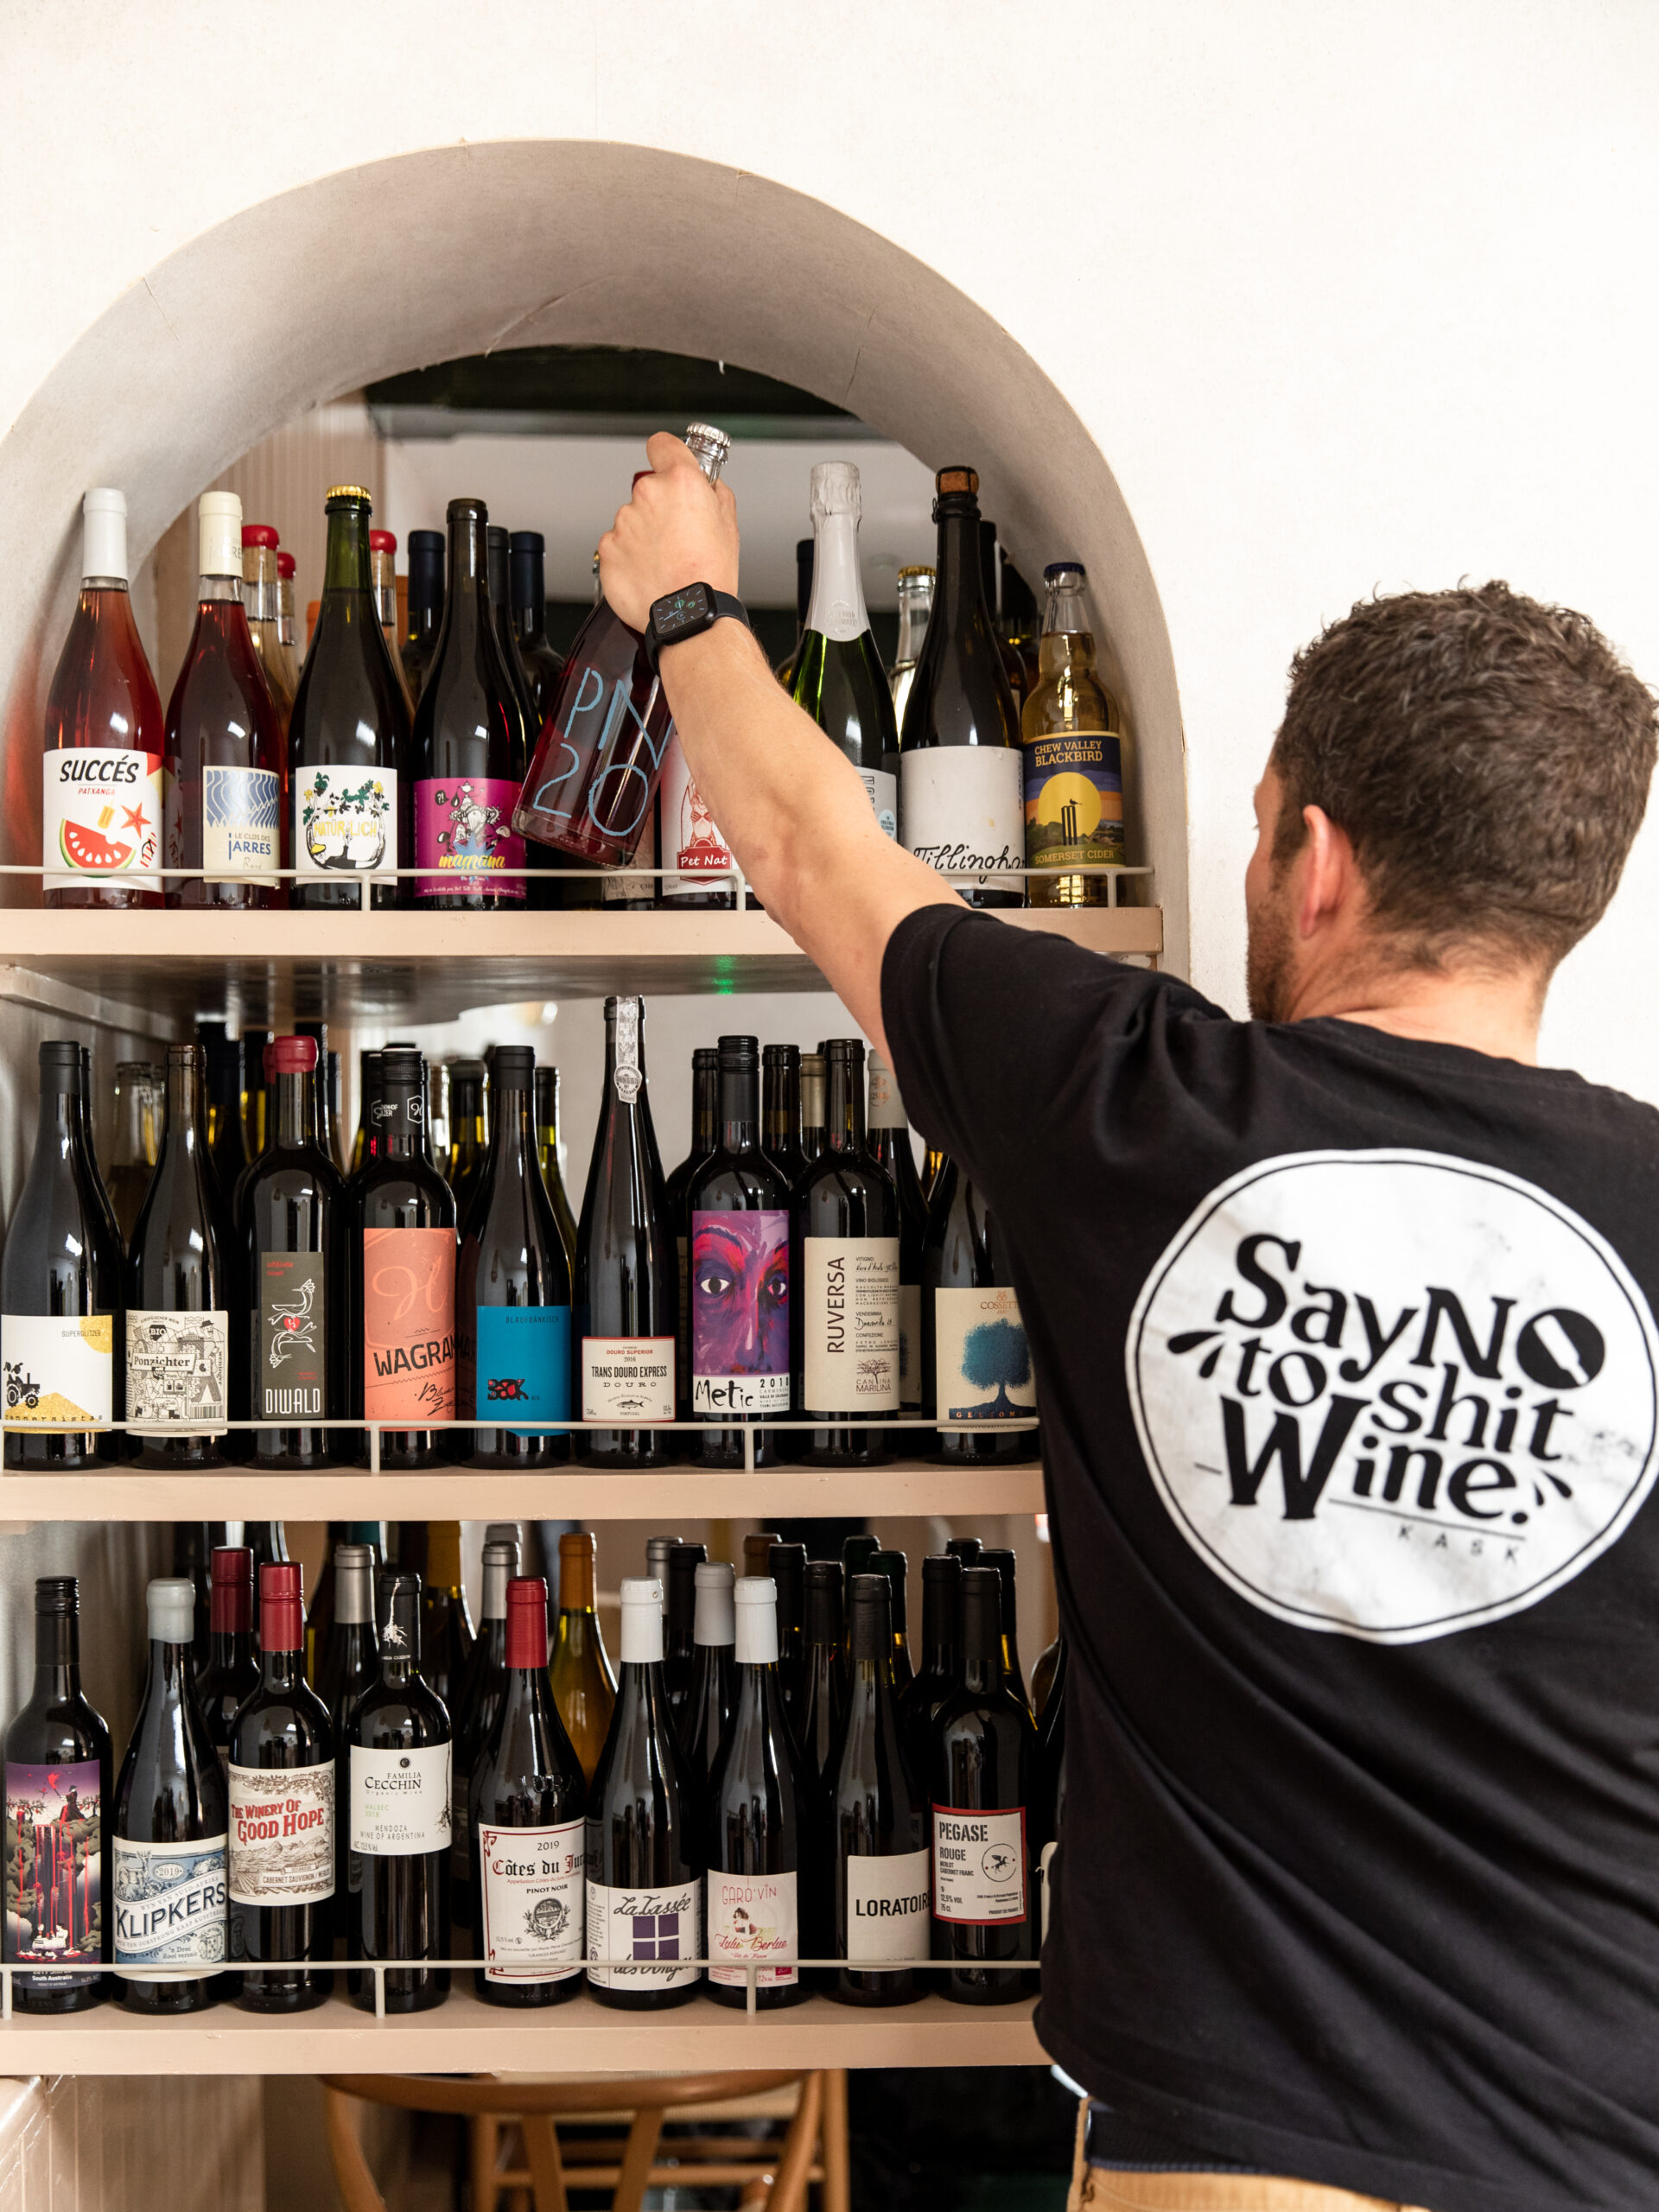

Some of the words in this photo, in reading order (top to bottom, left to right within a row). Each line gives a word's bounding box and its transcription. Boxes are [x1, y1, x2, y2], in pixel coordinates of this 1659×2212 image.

[1034, 742, 1062, 755] CHEW
[1065, 741, 1102, 751] VALLEY
[1035, 751, 1103, 767] BLACKBIRD
[60, 754, 140, 784] SUCCÉS
[78, 787, 116, 796] PATXANGA
[533, 742, 648, 836] 20
[680, 855, 701, 868] Pet
[703, 854, 728, 866] Nat
[1034, 850, 1085, 864] SOMERSET
[1086, 850, 1115, 859] CIDER
[827, 1255, 846, 1354] RUVERSA
[1214, 1232, 1420, 1382] Say
[1409, 1286, 1606, 1390] NO
[149, 1327, 167, 1337] BIO
[134, 1356, 190, 1368] Ponzichter
[592, 1366, 613, 1378] TRANS
[613, 1366, 638, 1378] DOURO
[639, 1365, 668, 1378] EXPRESS
[265, 1388, 321, 1414] DIWALD
[695, 1379, 754, 1410] Metic
[1235, 1337, 1328, 1408] to
[1370, 1360, 1575, 1461] shit
[1219, 1392, 1530, 1525] Wine.
[1397, 1524, 1520, 1565] KASK
[365, 1777, 422, 1790] CECCHIN
[245, 1802, 284, 1819] WINERY
[238, 1820, 279, 1846] GOOD
[283, 1808, 324, 1837] HOPE
[939, 1821, 988, 1842] PEGASE
[387, 1832, 425, 1840] ARGENTINA
[537, 1840, 560, 1851] 2019
[939, 1847, 966, 1861] ROUGE
[492, 1859, 536, 1876] Côtes
[542, 1860, 560, 1874] du
[940, 1867, 958, 1876] CABERNET
[115, 1882, 226, 1938] KLIPKERS
[613, 1896, 639, 1916] La
[639, 1892, 691, 1916] Tassée
[714, 1933, 741, 1950] Lulu
[741, 1936, 787, 1952] Berlue
